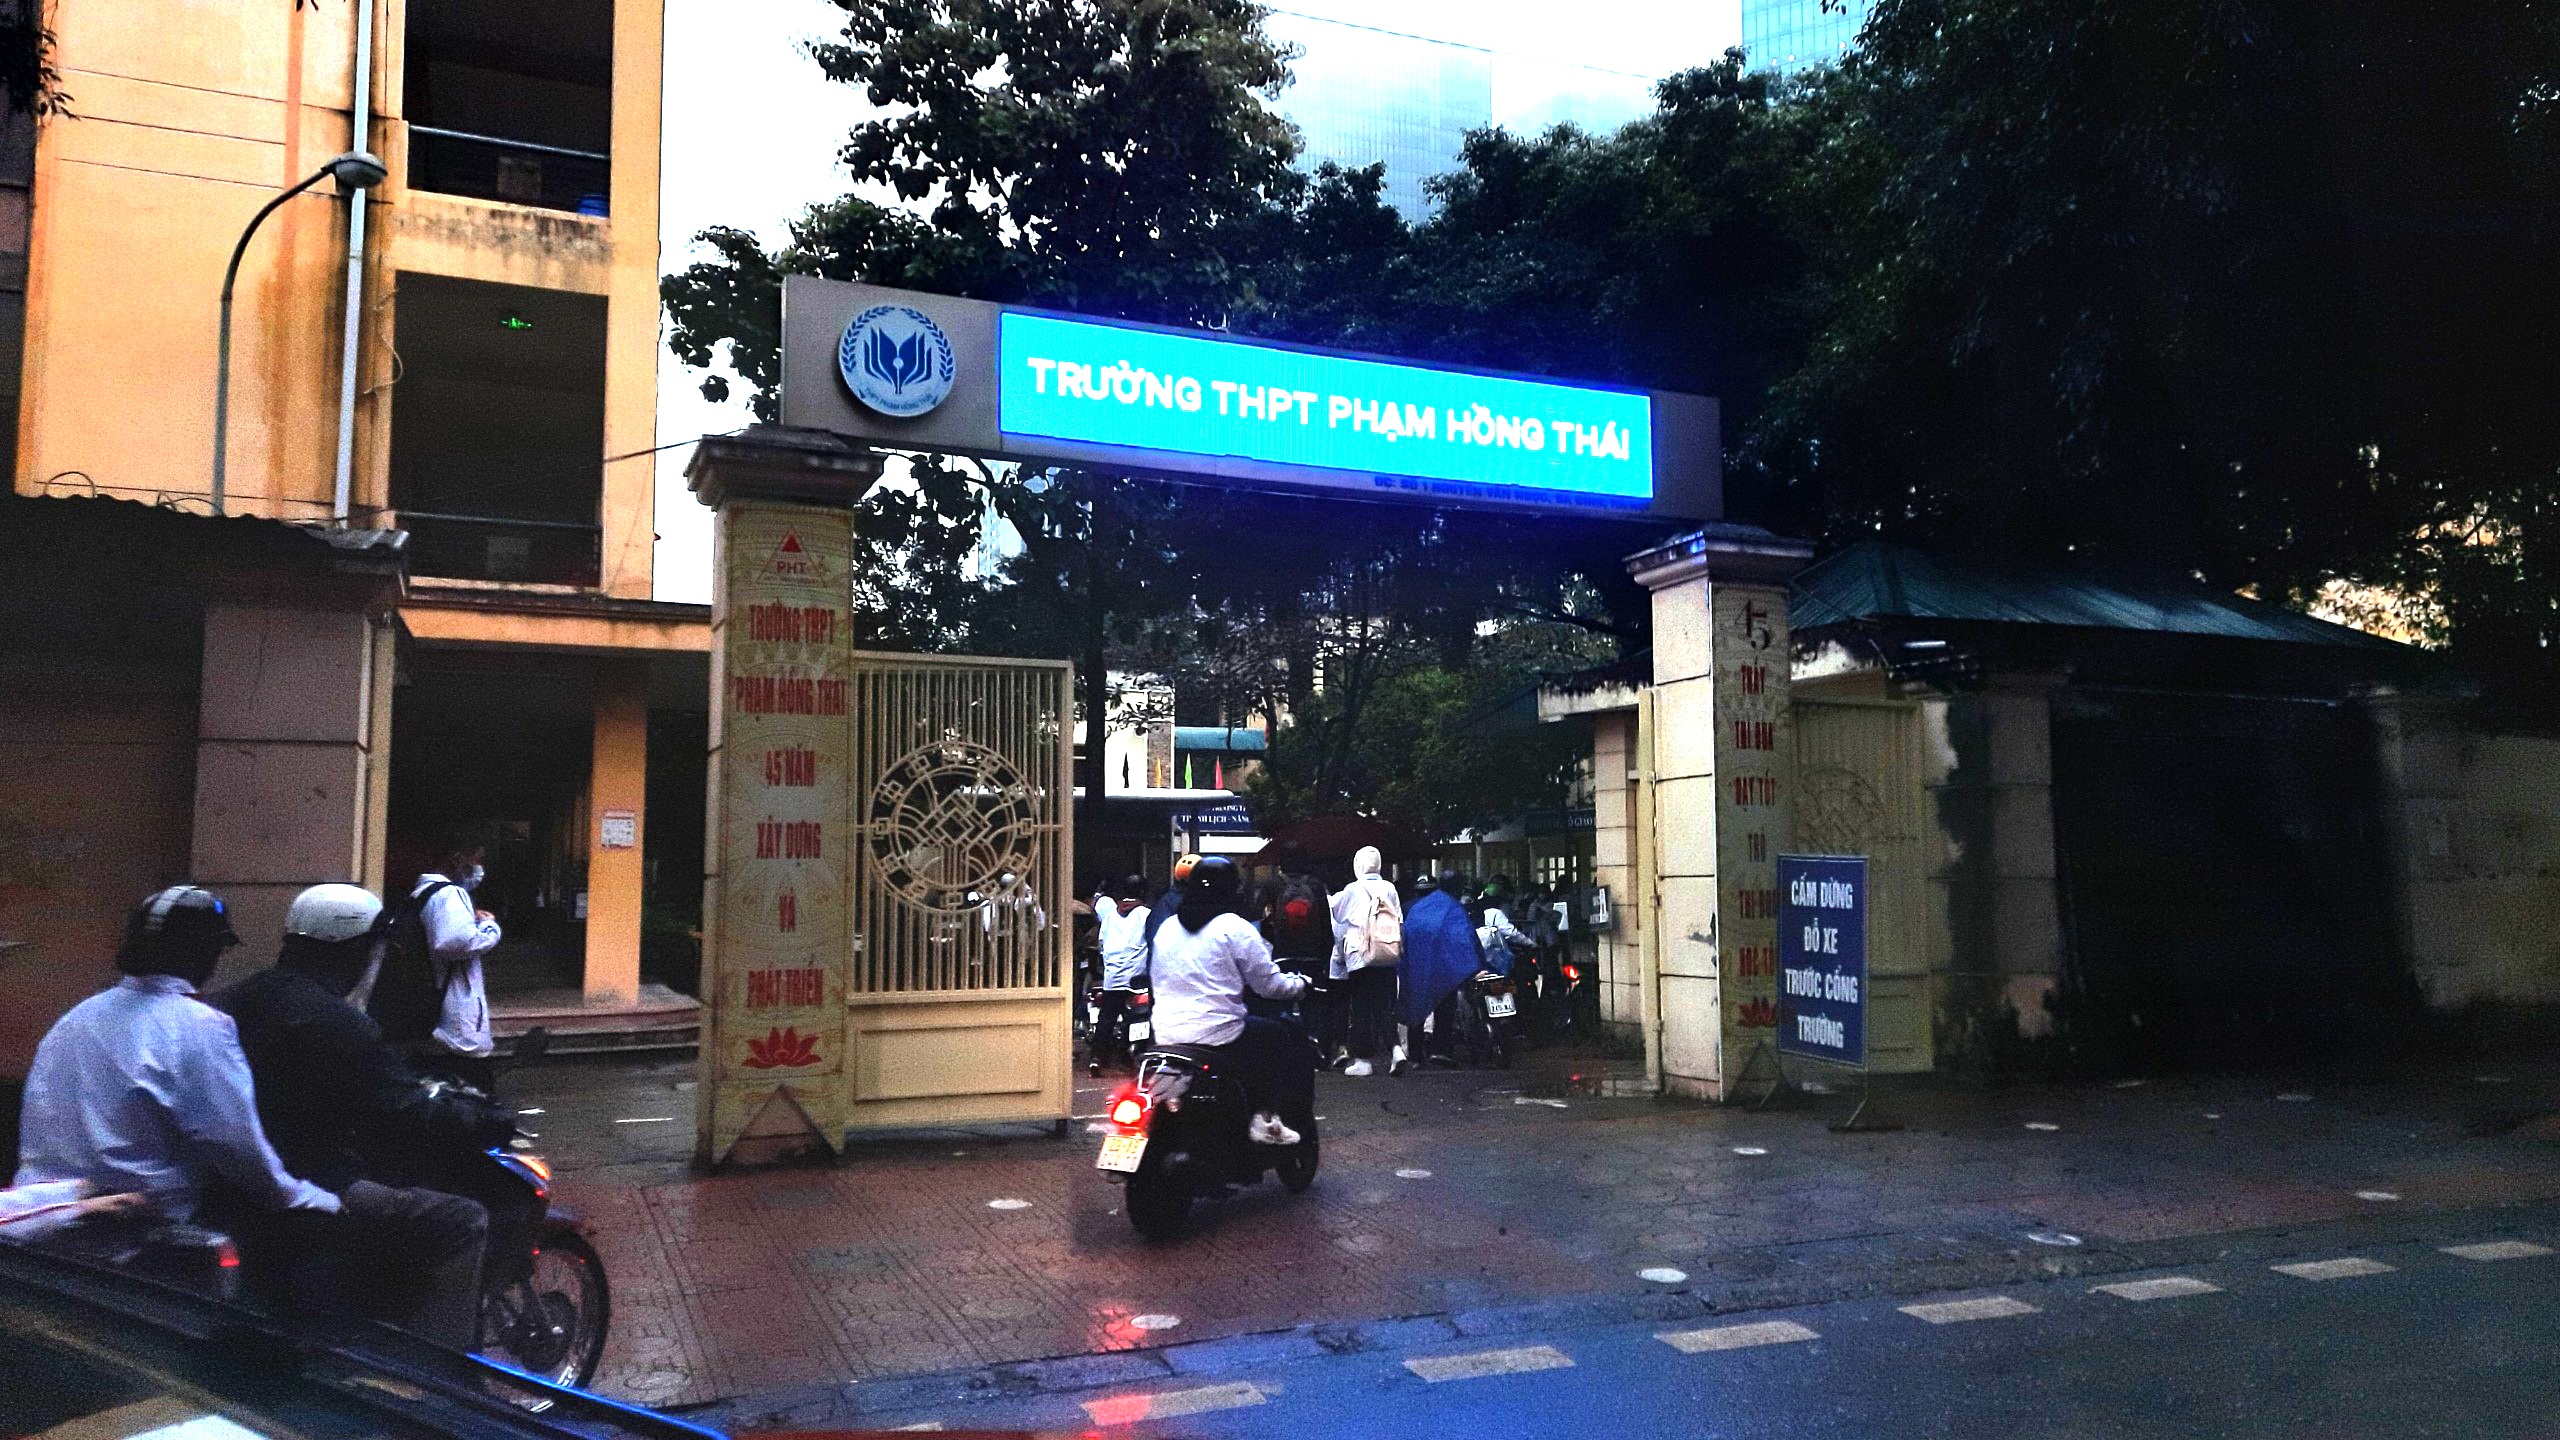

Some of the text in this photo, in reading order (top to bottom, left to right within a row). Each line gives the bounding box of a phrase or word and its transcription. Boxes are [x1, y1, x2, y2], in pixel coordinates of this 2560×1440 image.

[1028, 357, 1630, 460] TRƯỜNG THPT PHẠM HỒNG THÁI
[776, 561, 806, 574] PHT
[749, 597, 835, 644] TRƯỜNG THPT
[736, 667, 846, 721] PHẠM HỒNG THÁI
[766, 743, 815, 787] 45 NĂM
[757, 815, 821, 866] XÂY DỰNG
[1791, 872, 1853, 909] CẤM DỪNG
[1804, 917, 1838, 954] ĐỖ XE
[747, 962, 782, 1008] PHÁT
[1785, 965, 1858, 1004] TRƯỚC CỔNG
[1798, 1012, 1844, 1049] TRƯỜNG
